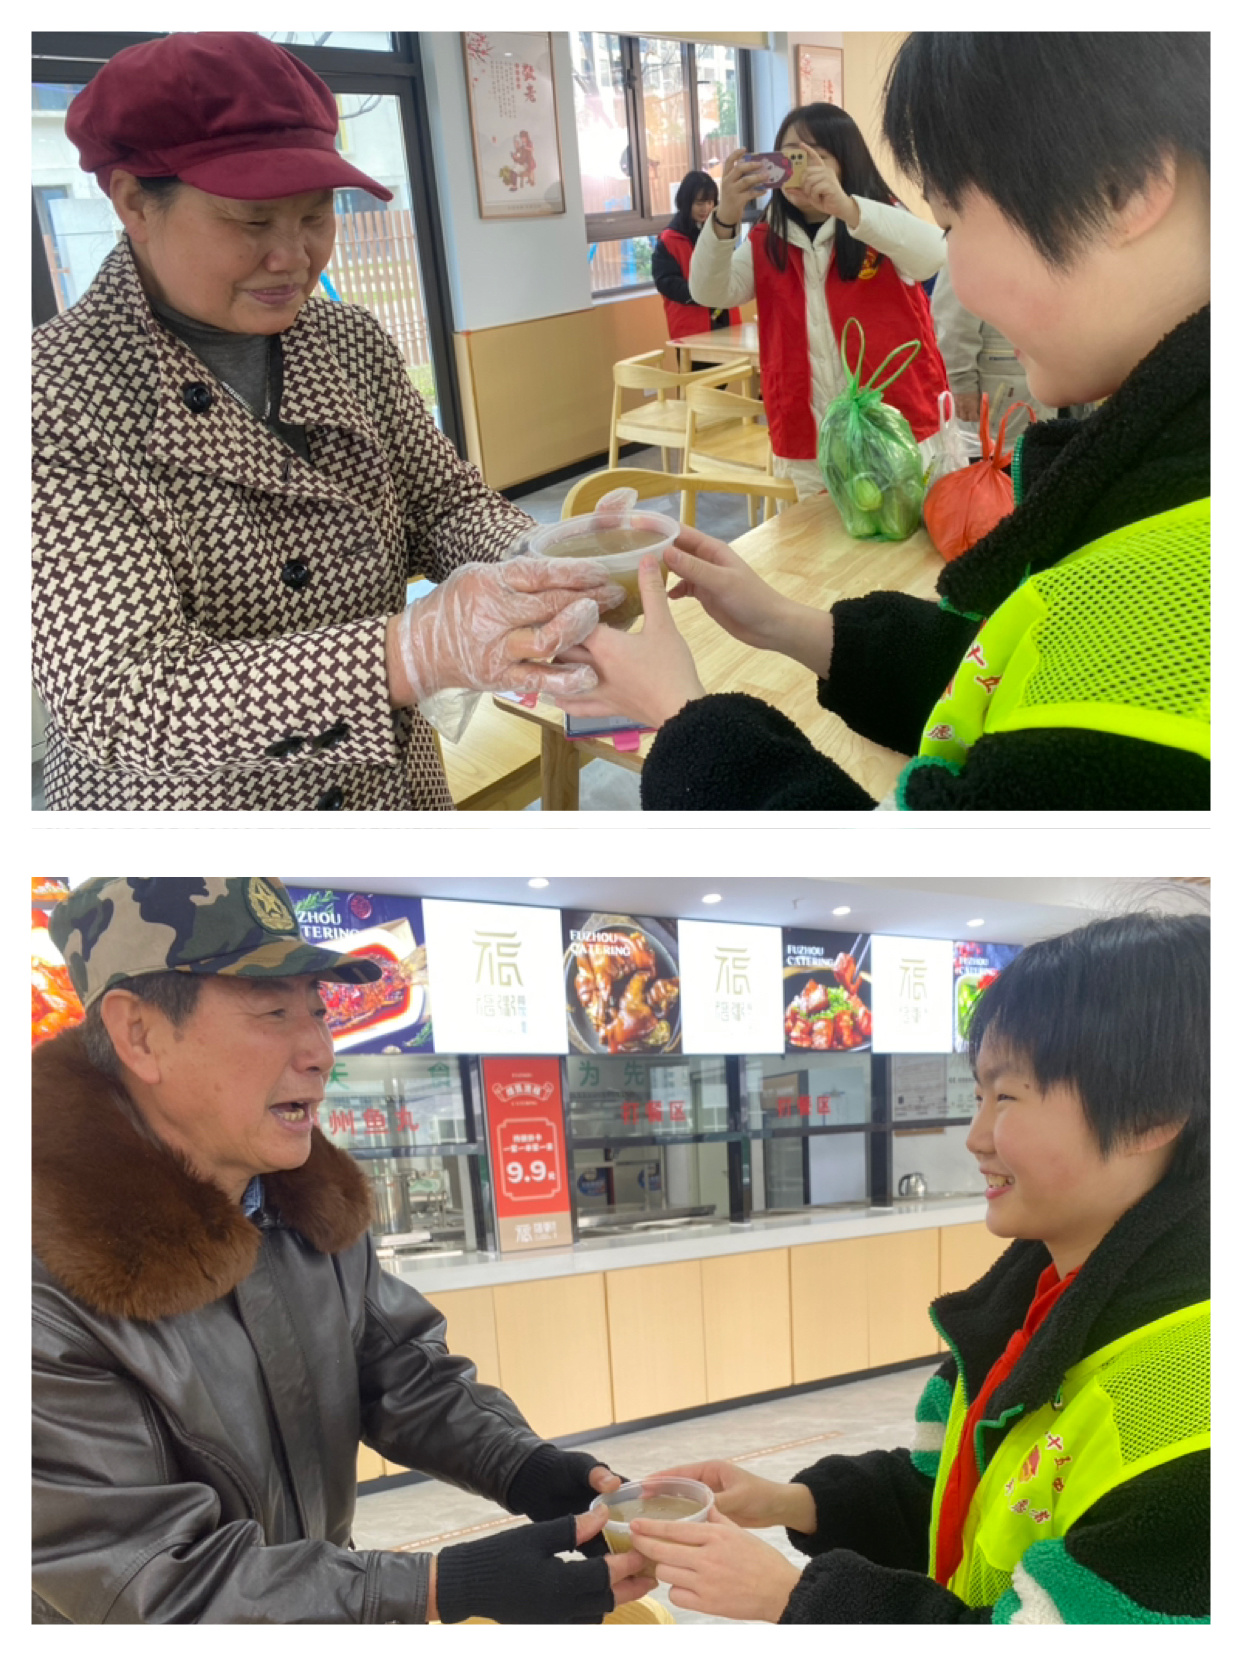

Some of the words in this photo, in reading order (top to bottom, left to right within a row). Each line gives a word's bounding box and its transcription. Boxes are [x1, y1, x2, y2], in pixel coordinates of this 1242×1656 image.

[569, 929, 617, 943] FUZHOU
[570, 941, 631, 957] CATERING
[787, 944, 824, 956] FUZHOU
[314, 1104, 420, 1136] 州鱼丸
